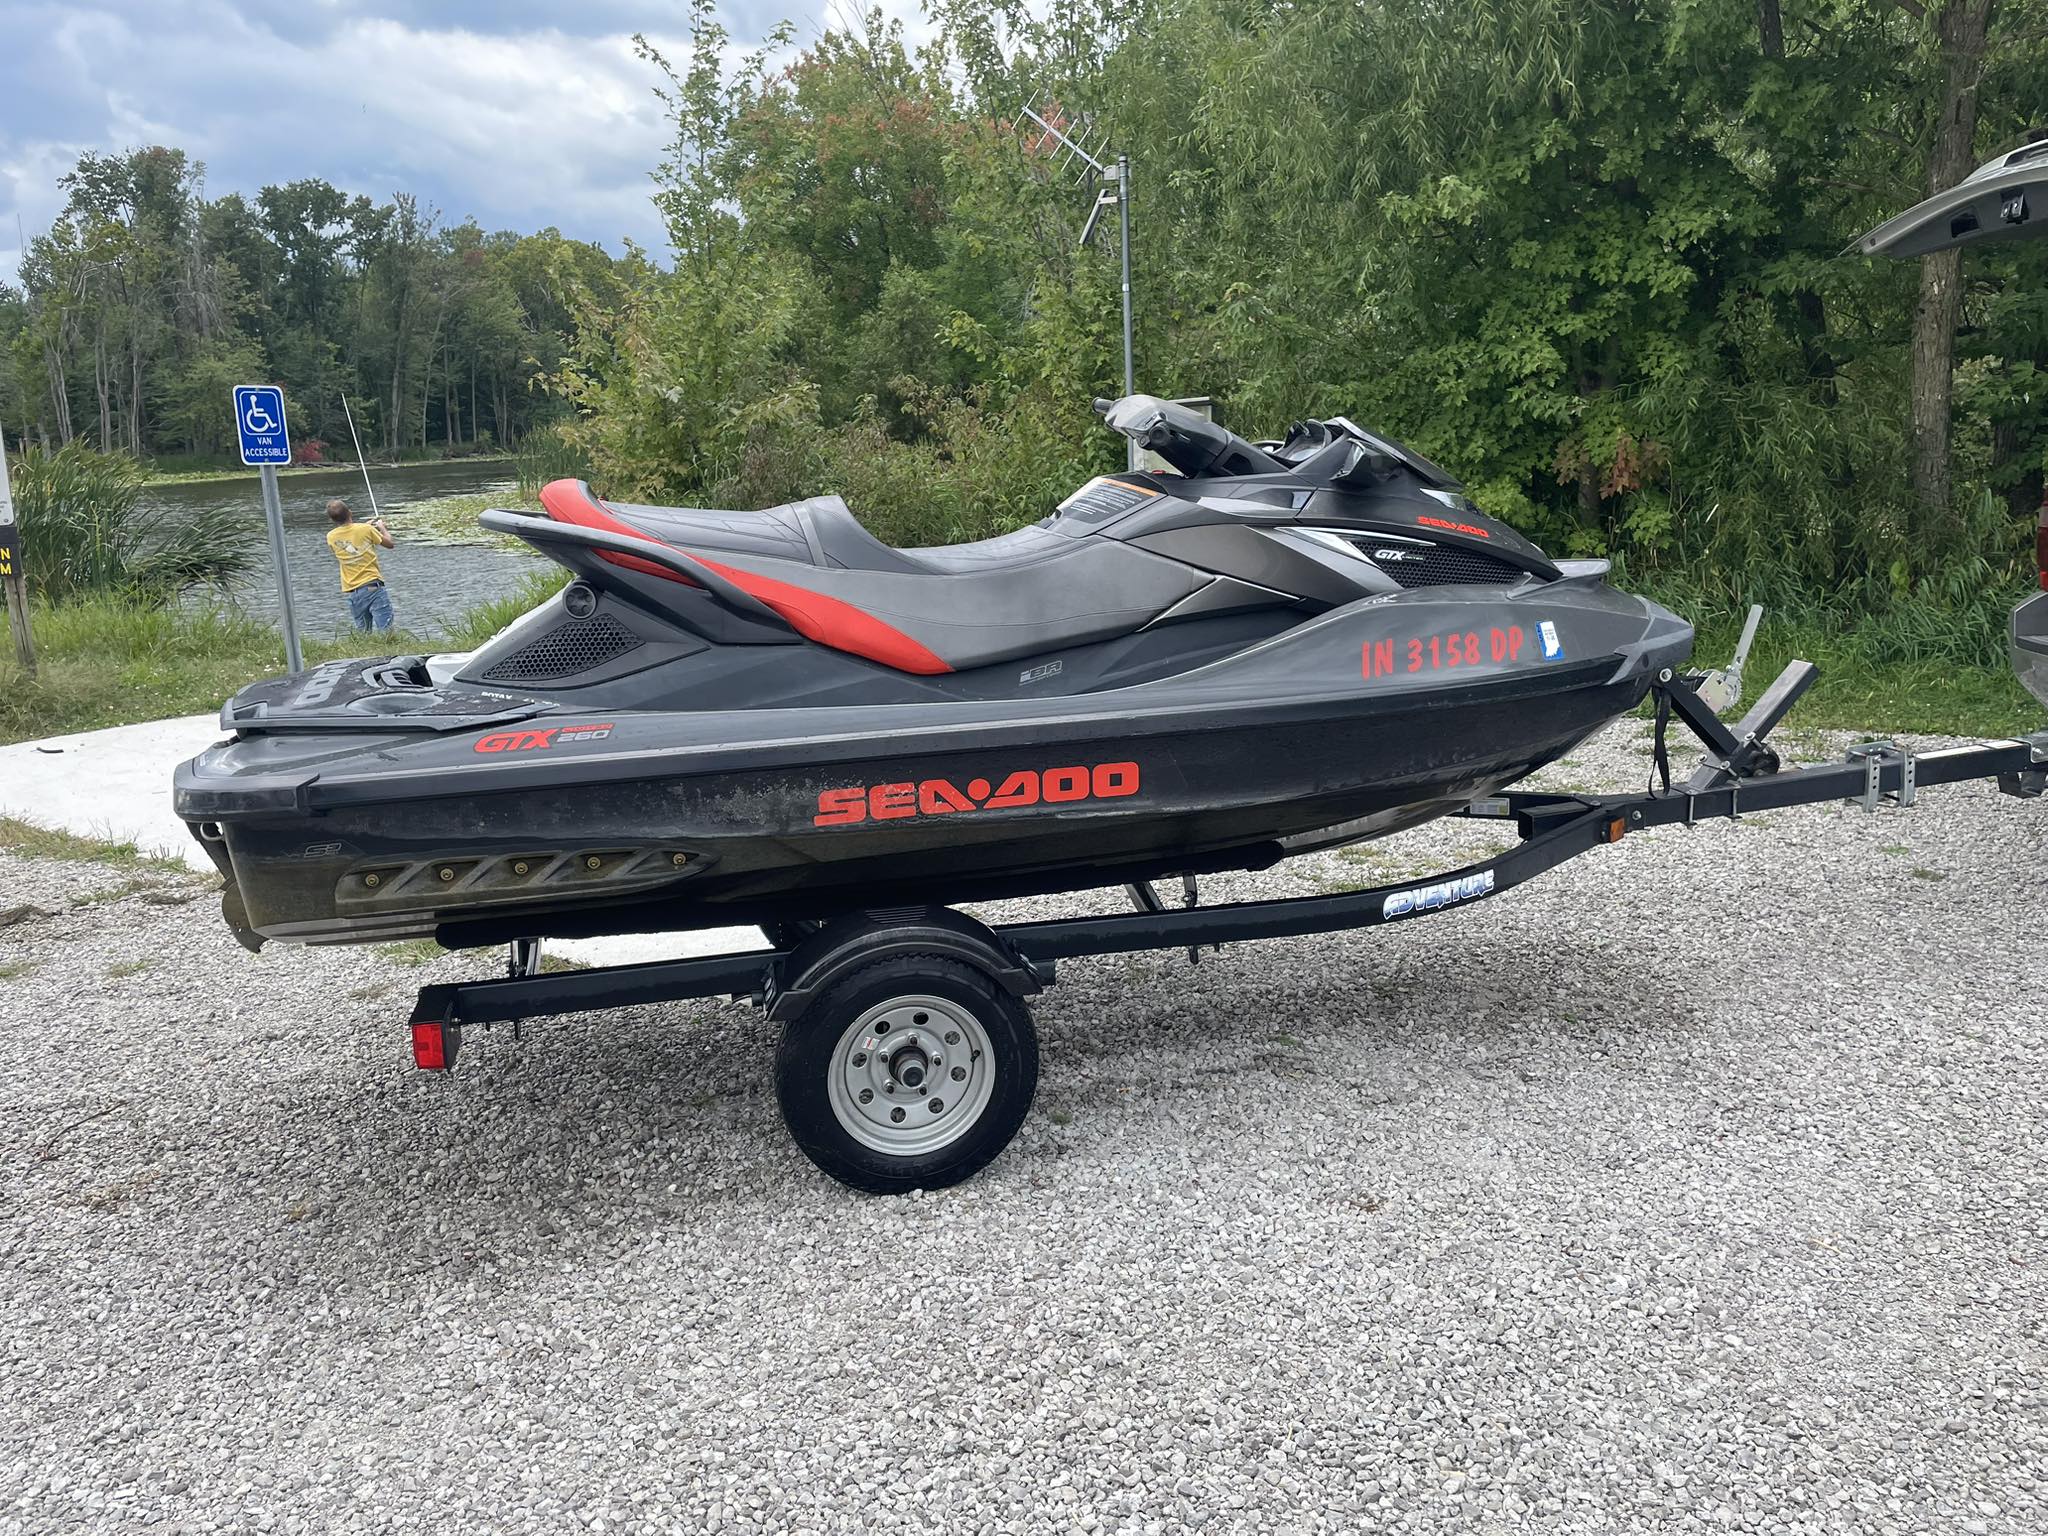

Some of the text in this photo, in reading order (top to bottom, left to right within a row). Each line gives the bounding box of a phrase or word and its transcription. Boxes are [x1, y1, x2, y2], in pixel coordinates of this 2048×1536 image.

[257, 437, 272, 445] VAN
[245, 448, 288, 457] ACCESSIBLE
[1375, 549, 1406, 561] GTX
[1361, 638, 1393, 681] IN
[1406, 632, 1481, 674] 3158
[1490, 625, 1525, 662] DP
[474, 729, 611, 753] GTX 260
[1383, 869, 1495, 920] ADVENTURE
